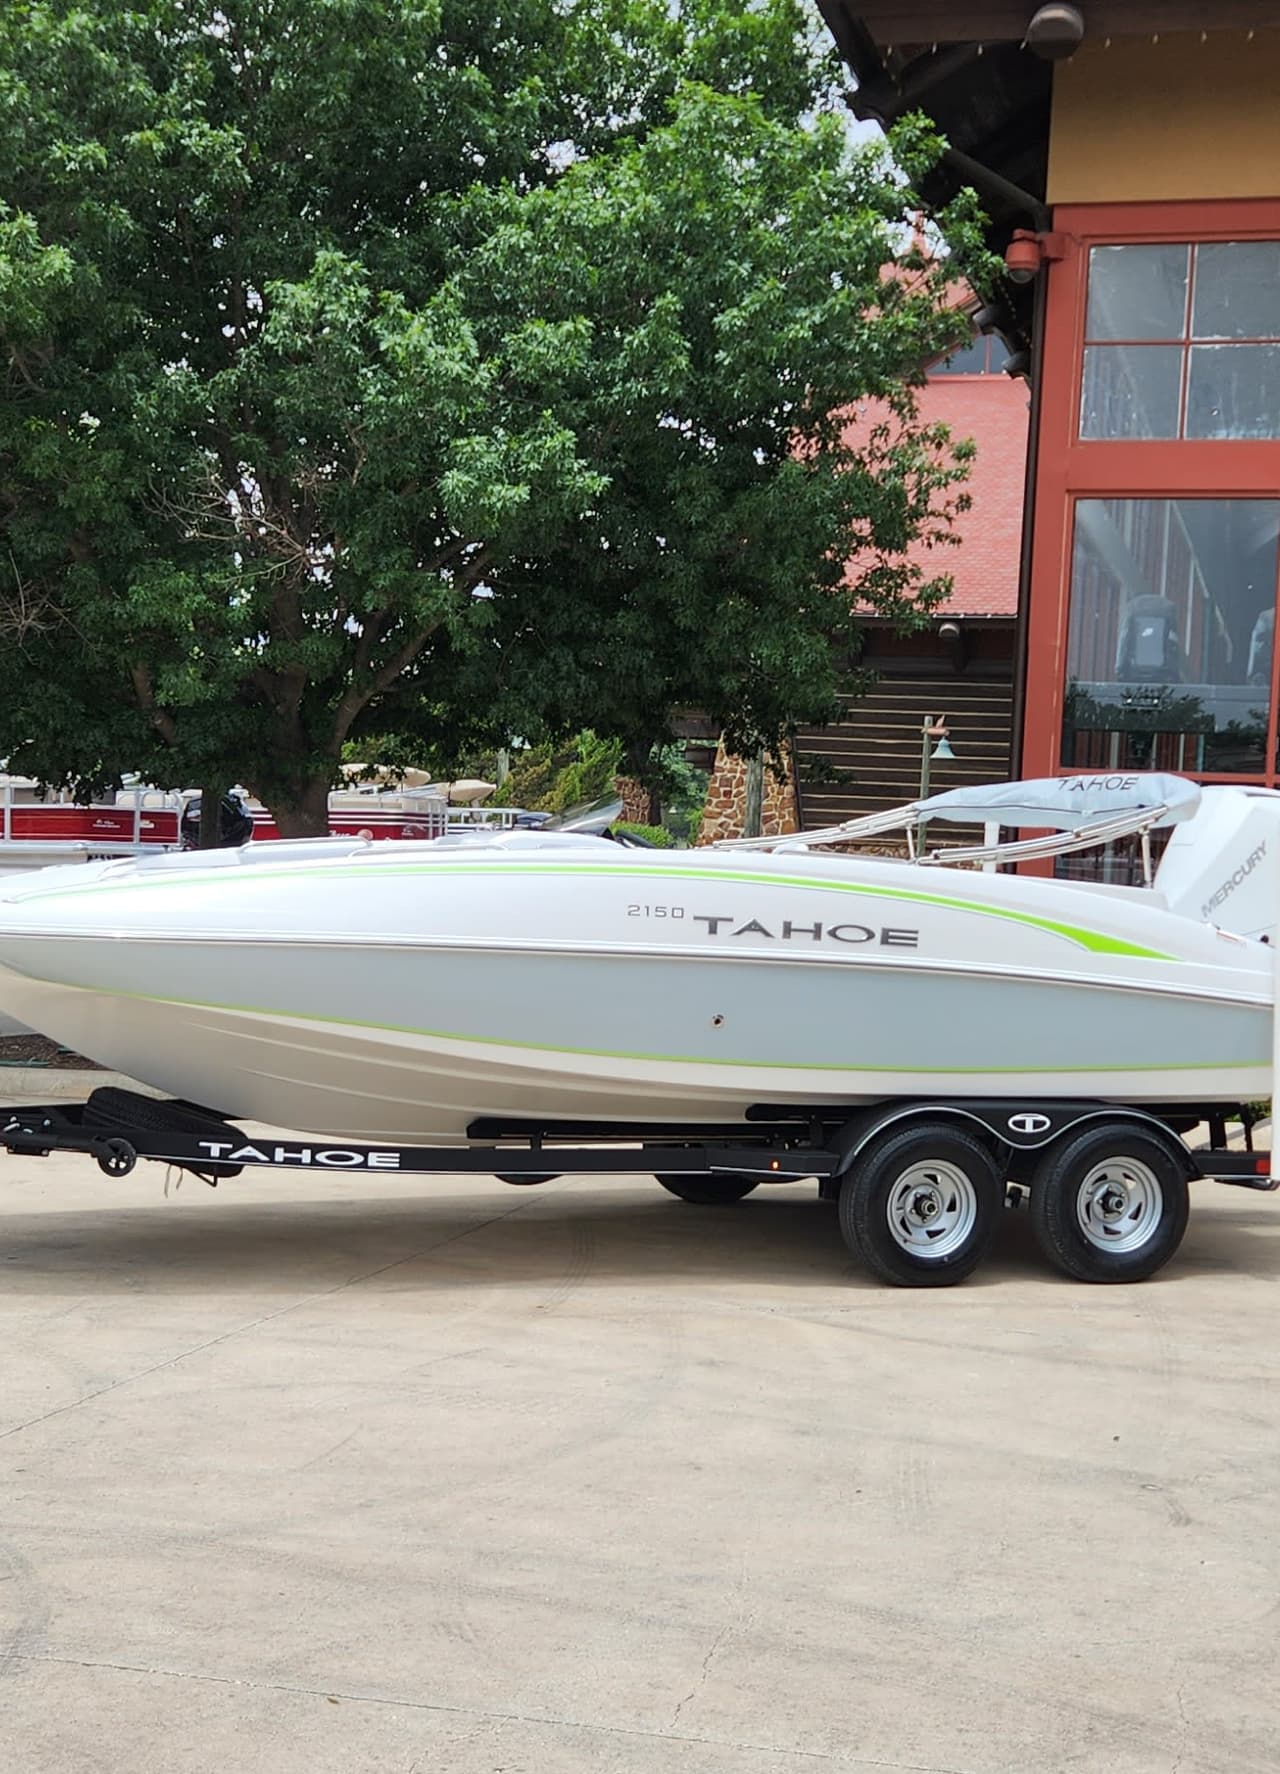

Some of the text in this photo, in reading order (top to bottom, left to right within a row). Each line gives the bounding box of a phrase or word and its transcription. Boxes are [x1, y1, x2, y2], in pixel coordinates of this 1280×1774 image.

[1058, 776, 1139, 792] TAHOE
[1200, 840, 1267, 918] MERCURY
[627, 905, 685, 919] 2150
[693, 915, 920, 948] TAHOE
[198, 1141, 401, 1168] TAHOE
